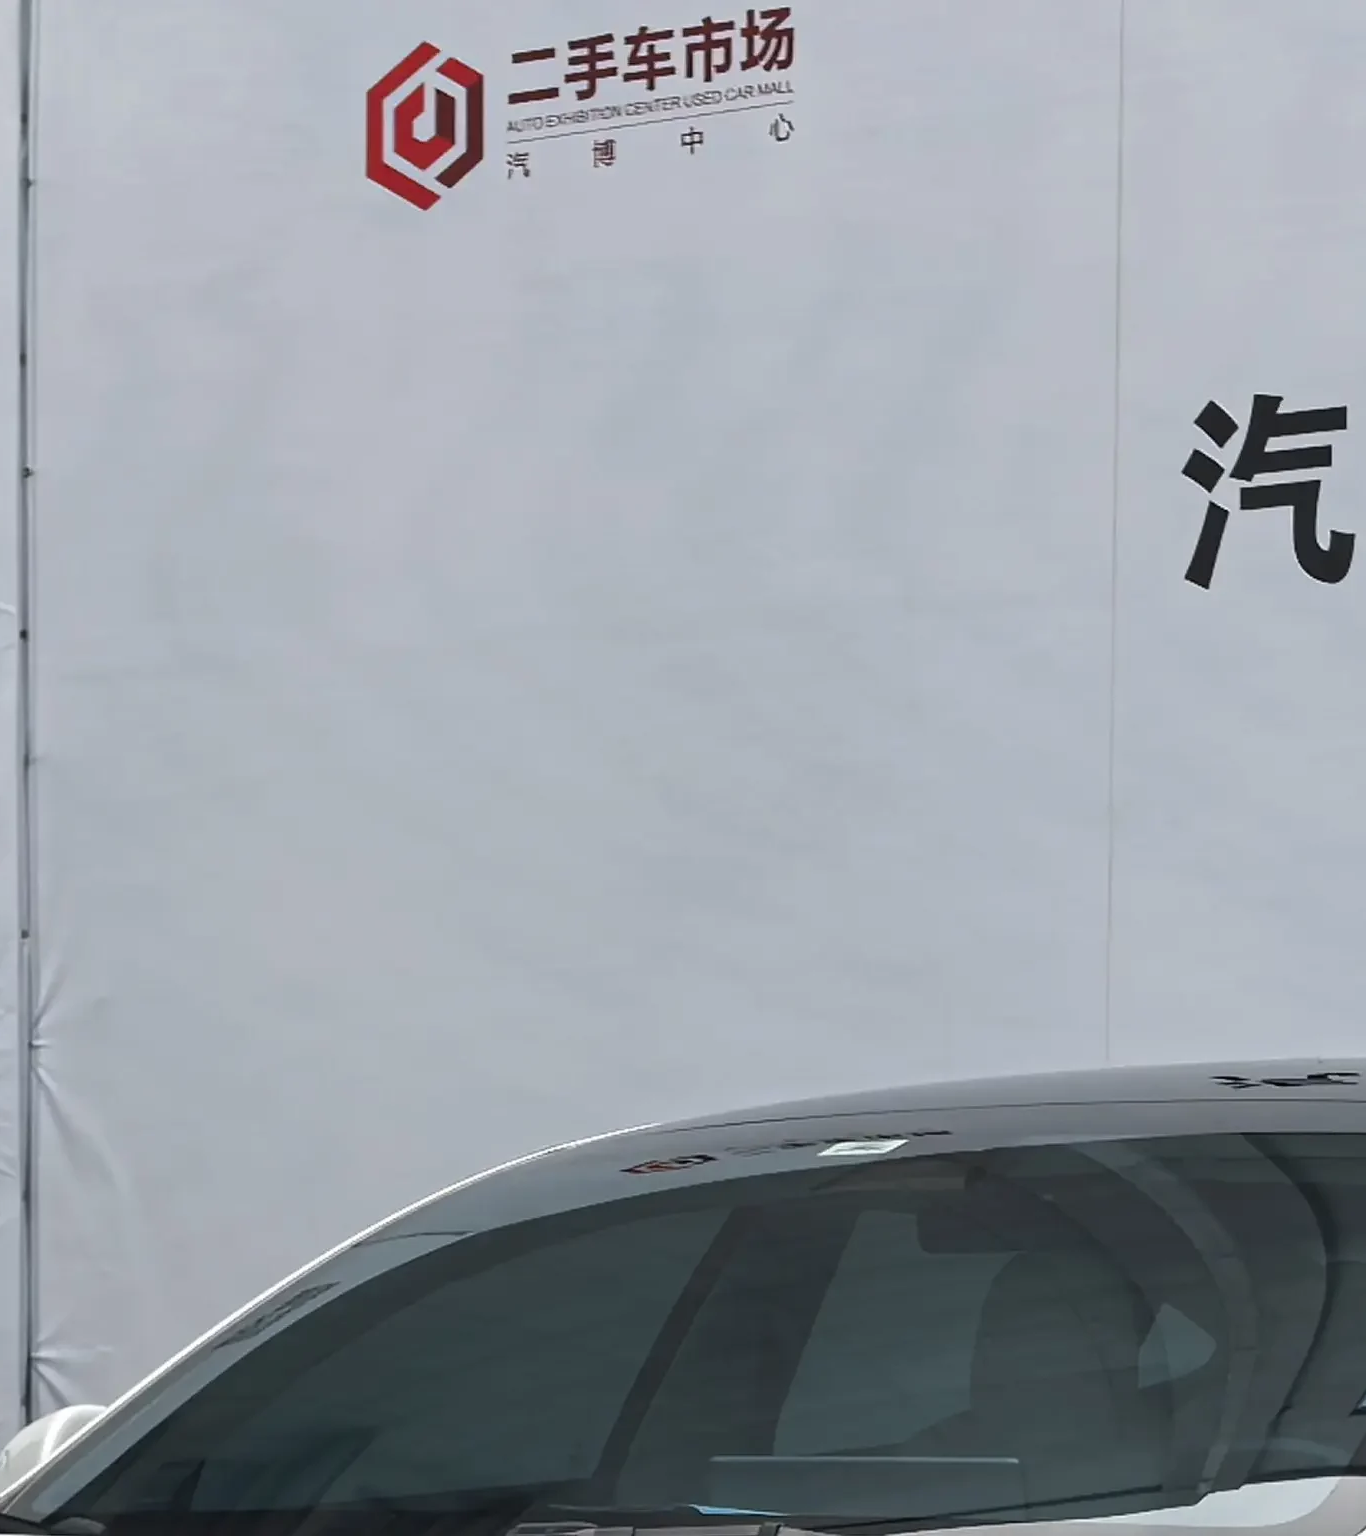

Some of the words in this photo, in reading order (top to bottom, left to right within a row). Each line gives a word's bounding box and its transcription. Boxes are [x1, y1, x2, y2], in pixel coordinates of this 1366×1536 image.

[507, 5, 796, 105] 二手车市场
[506, 114, 544, 133] AUTO
[546, 104, 623, 129] EXHIBITION
[624, 95, 682, 117] CENTER
[683, 89, 724, 109] USED
[725, 85, 754, 102] CAR
[756, 79, 795, 98] MALL
